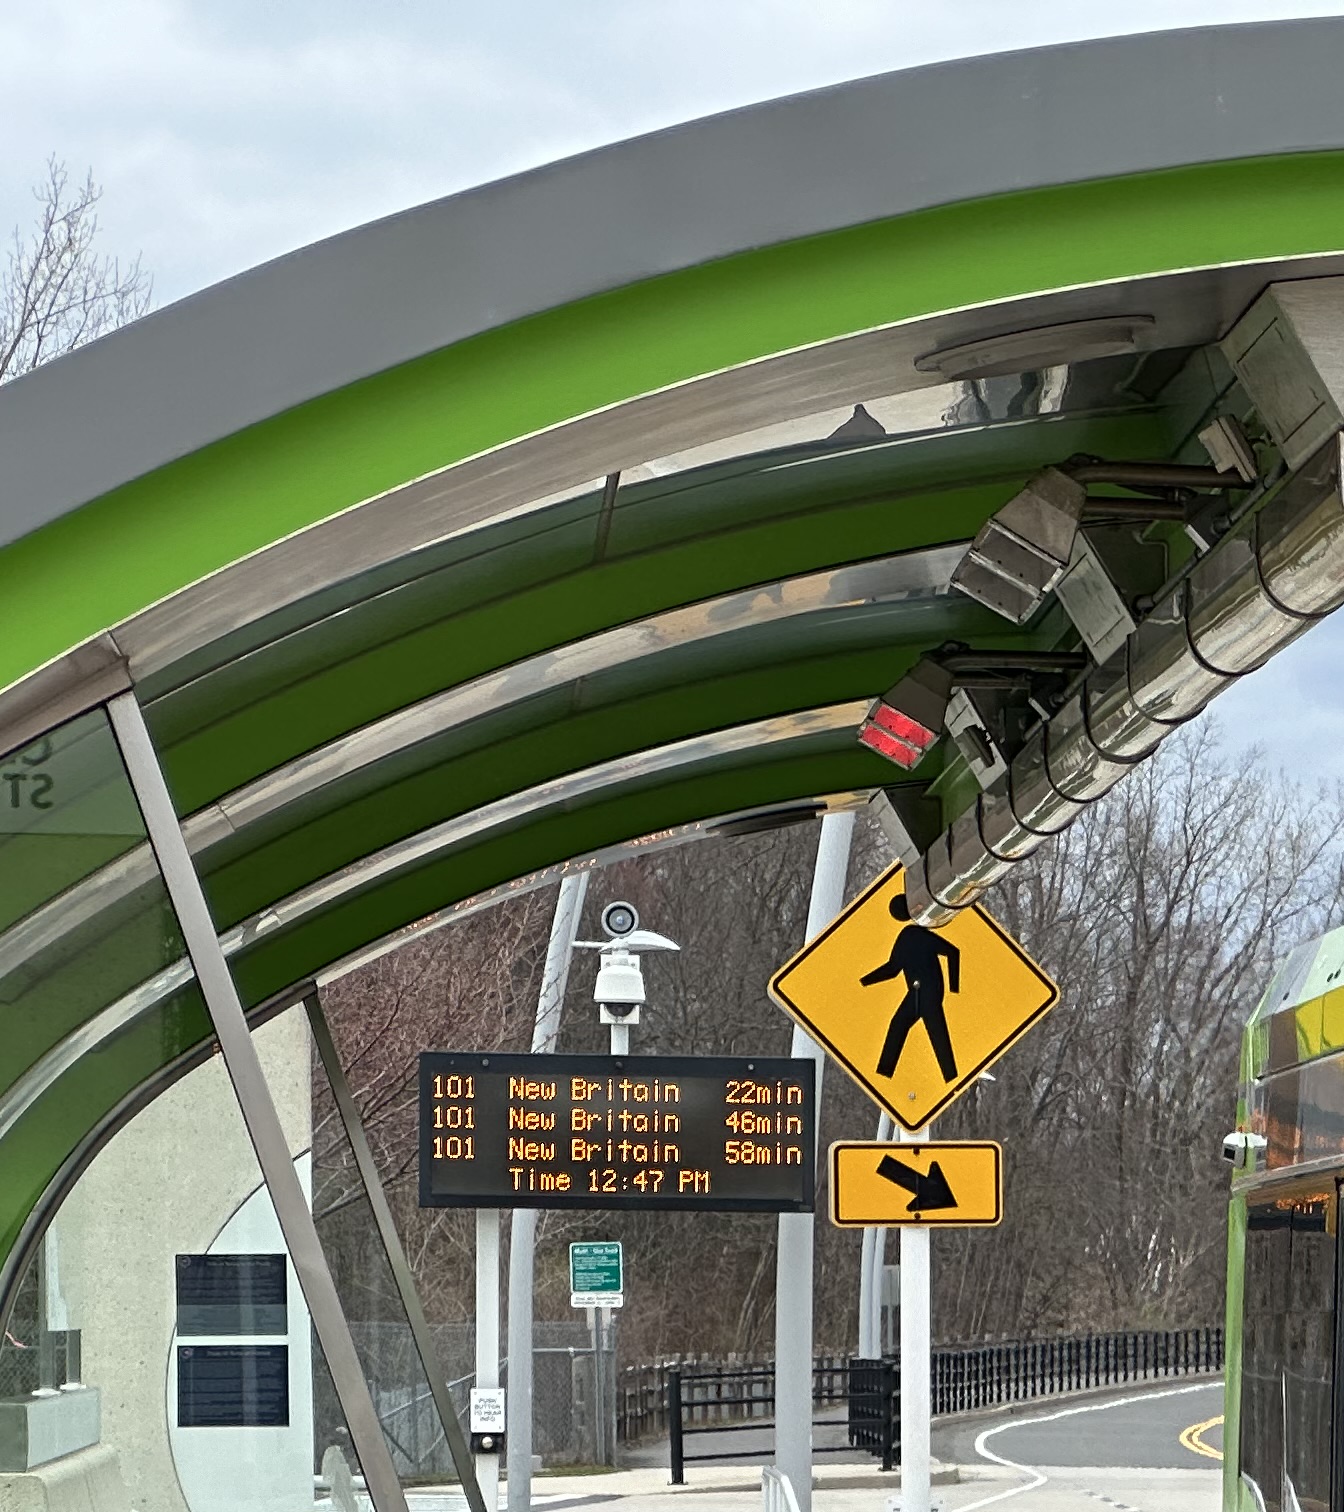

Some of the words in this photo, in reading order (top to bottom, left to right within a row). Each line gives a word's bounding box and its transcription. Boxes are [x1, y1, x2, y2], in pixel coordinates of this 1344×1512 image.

[432, 1075, 475, 1100] 101
[509, 1077, 556, 1101] New
[571, 1077, 680, 1104] Britain
[725, 1080, 803, 1105] 22min
[432, 1106, 475, 1130] 101
[509, 1107, 556, 1132] New
[571, 1108, 680, 1133] Britain
[725, 1110, 803, 1135] 46min
[432, 1136, 475, 1160] 101
[509, 1137, 556, 1162] New
[571, 1138, 680, 1164] Britain
[725, 1140, 803, 1166] 58min
[509, 1167, 571, 1192] Time
[588, 1169, 663, 1193] 12:47
[679, 1170, 710, 1194] PM
